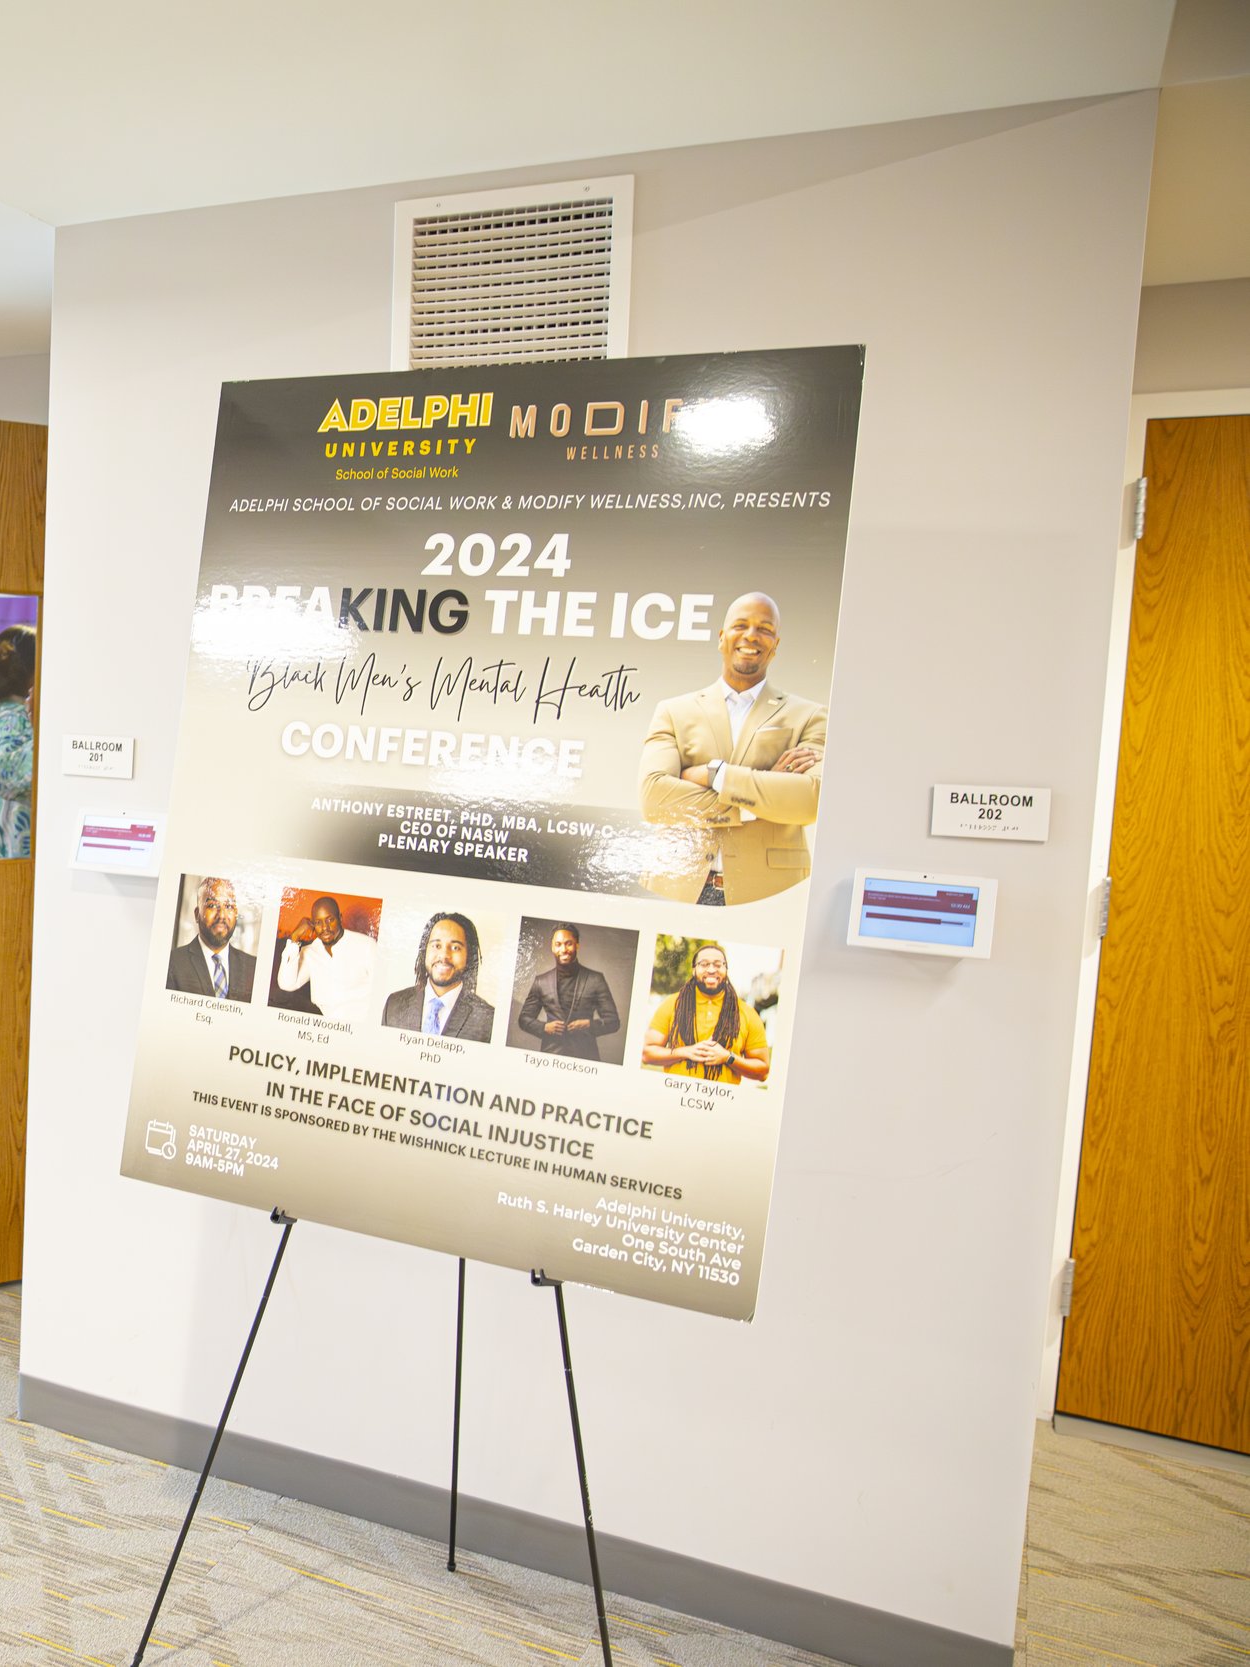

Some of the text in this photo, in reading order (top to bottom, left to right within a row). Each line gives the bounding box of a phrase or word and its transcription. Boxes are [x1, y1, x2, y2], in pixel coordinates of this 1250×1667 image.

[317, 392, 494, 433] ADELPHI
[509, 398, 695, 438] MODIF
[325, 438, 476, 458] UNIVERSITY
[566, 444, 659, 460] WELLNESS
[335, 465, 459, 480] School of Social Work
[229, 498, 289, 512] ADELPHI
[292, 497, 355, 512] SCHOOL
[360, 496, 382, 511] OF
[385, 496, 443, 510] SOCIAL
[450, 495, 497, 510] WORK
[501, 495, 513, 509] &
[517, 494, 586, 510] MODIFY
[733, 491, 831, 509] PRESENTS
[420, 532, 571, 577] 2024
[485, 590, 597, 637] THE
[610, 592, 714, 641] ICE
[246, 652, 641, 724] Black Men's Mental Health
[72, 740, 123, 752] BALLROOM
[89, 752, 103, 762] 201
[281, 721, 585, 778] CONFERENCE
[950, 792, 1033, 808] BALLROOM
[311, 797, 384, 816] ANTHONY
[386, 804, 455, 824] ESTREET,
[460, 811, 494, 829] PHD,
[502, 815, 542, 834] MBA,
[978, 808, 1002, 820] 202
[400, 821, 509, 844] CEO OF NASW
[378, 834, 529, 863] PLENARY SPEAKER
[170, 993, 244, 1016] Richard Celestin,
[195, 1013, 214, 1025] Esq.
[277, 1012, 354, 1035] Ronald Woodall,
[297, 1030, 330, 1045] MS, Ed
[399, 1033, 466, 1055] Ryan Delapp,
[419, 1051, 441, 1064] PhD
[523, 1053, 598, 1075] Tayo Rockson
[228, 1045, 654, 1140] POLICY, IMPLEMENTATION AND PRACTICE
[664, 1077, 735, 1100] Gary Taylor,
[680, 1097, 715, 1112] LCSW
[266, 1081, 595, 1160] IN THE FACE OF SOCIAL INJUSTICE
[189, 1124, 257, 1150] SATURDAY
[192, 1091, 683, 1200] THIS EVENT IS SPONSORED BY THE WISHNICK LECTURE IN HUMAN SERVICES
[185, 1152, 245, 1177] 9AM-5PM
[186, 1140, 279, 1170] APRIL 27, 2024
[497, 1191, 744, 1255] Ruth S. Harley University Center
[595, 1197, 746, 1242] Adelphi University,
[572, 1237, 740, 1286] Garden City, NY 11530
[622, 1234, 742, 1271] One South Ave
